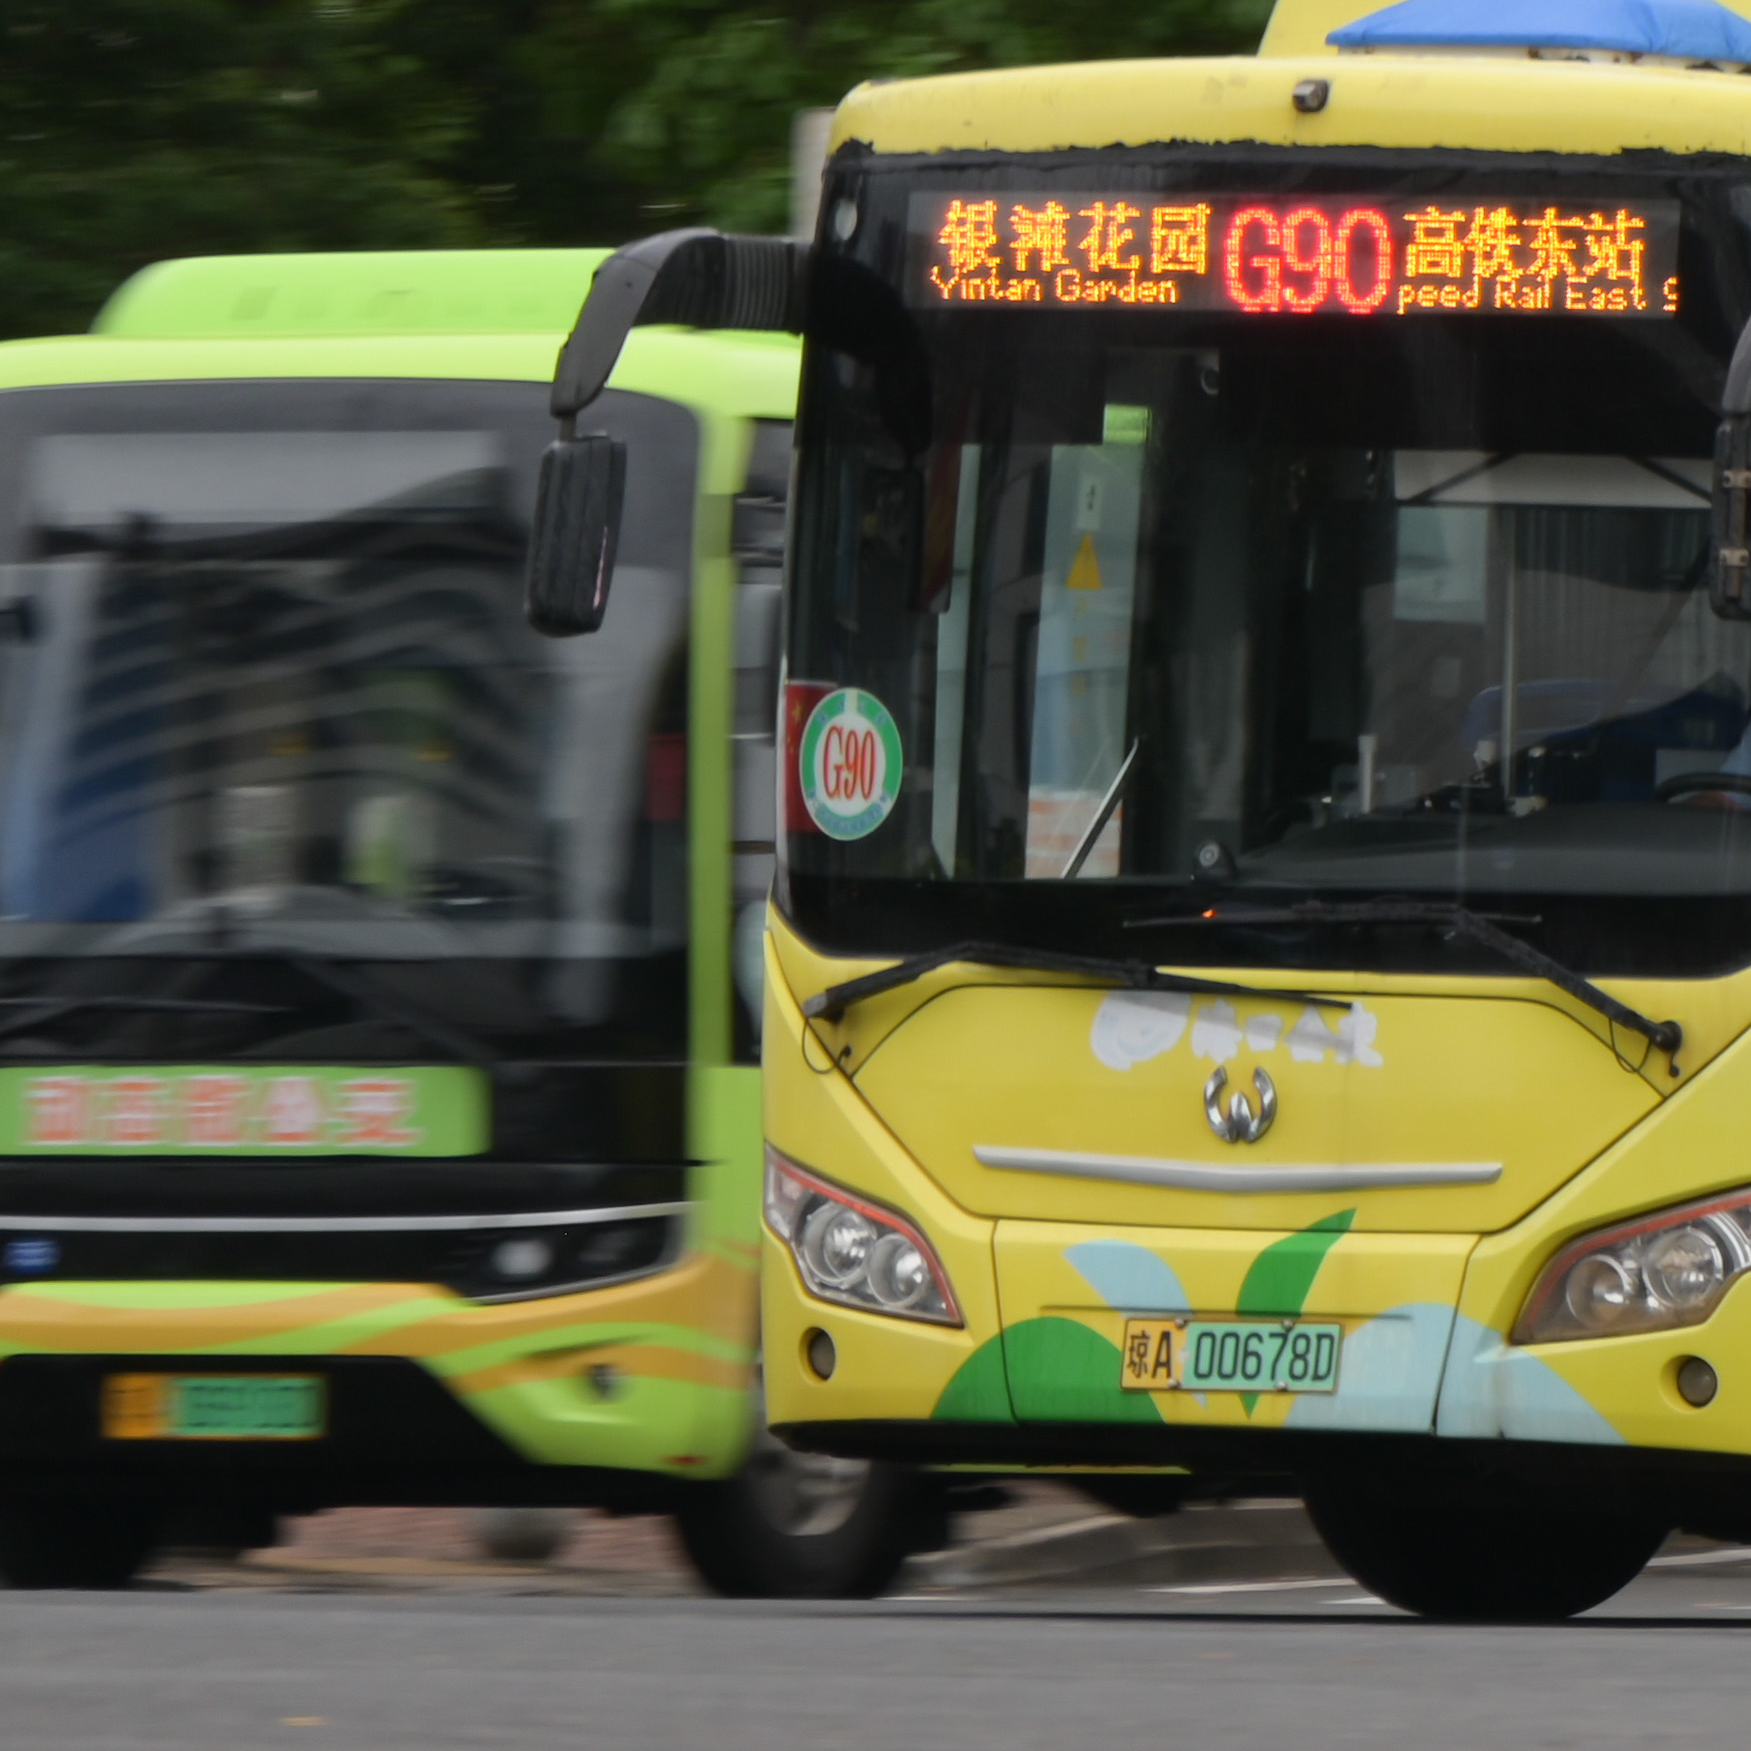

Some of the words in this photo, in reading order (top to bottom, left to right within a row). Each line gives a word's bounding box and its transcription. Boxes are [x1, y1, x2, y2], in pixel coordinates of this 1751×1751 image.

[938, 199, 1211, 274] 银滩花园
[1224, 206, 1394, 315] G90
[1402, 205, 1646, 280] 高铁东站
[930, 264, 1042, 301] Yintan
[1055, 267, 1178, 304] Garden
[1397, 274, 1481, 315] peed
[1494, 274, 1552, 310] Rail
[1565, 275, 1648, 311] East
[823, 725, 877, 803] G90
